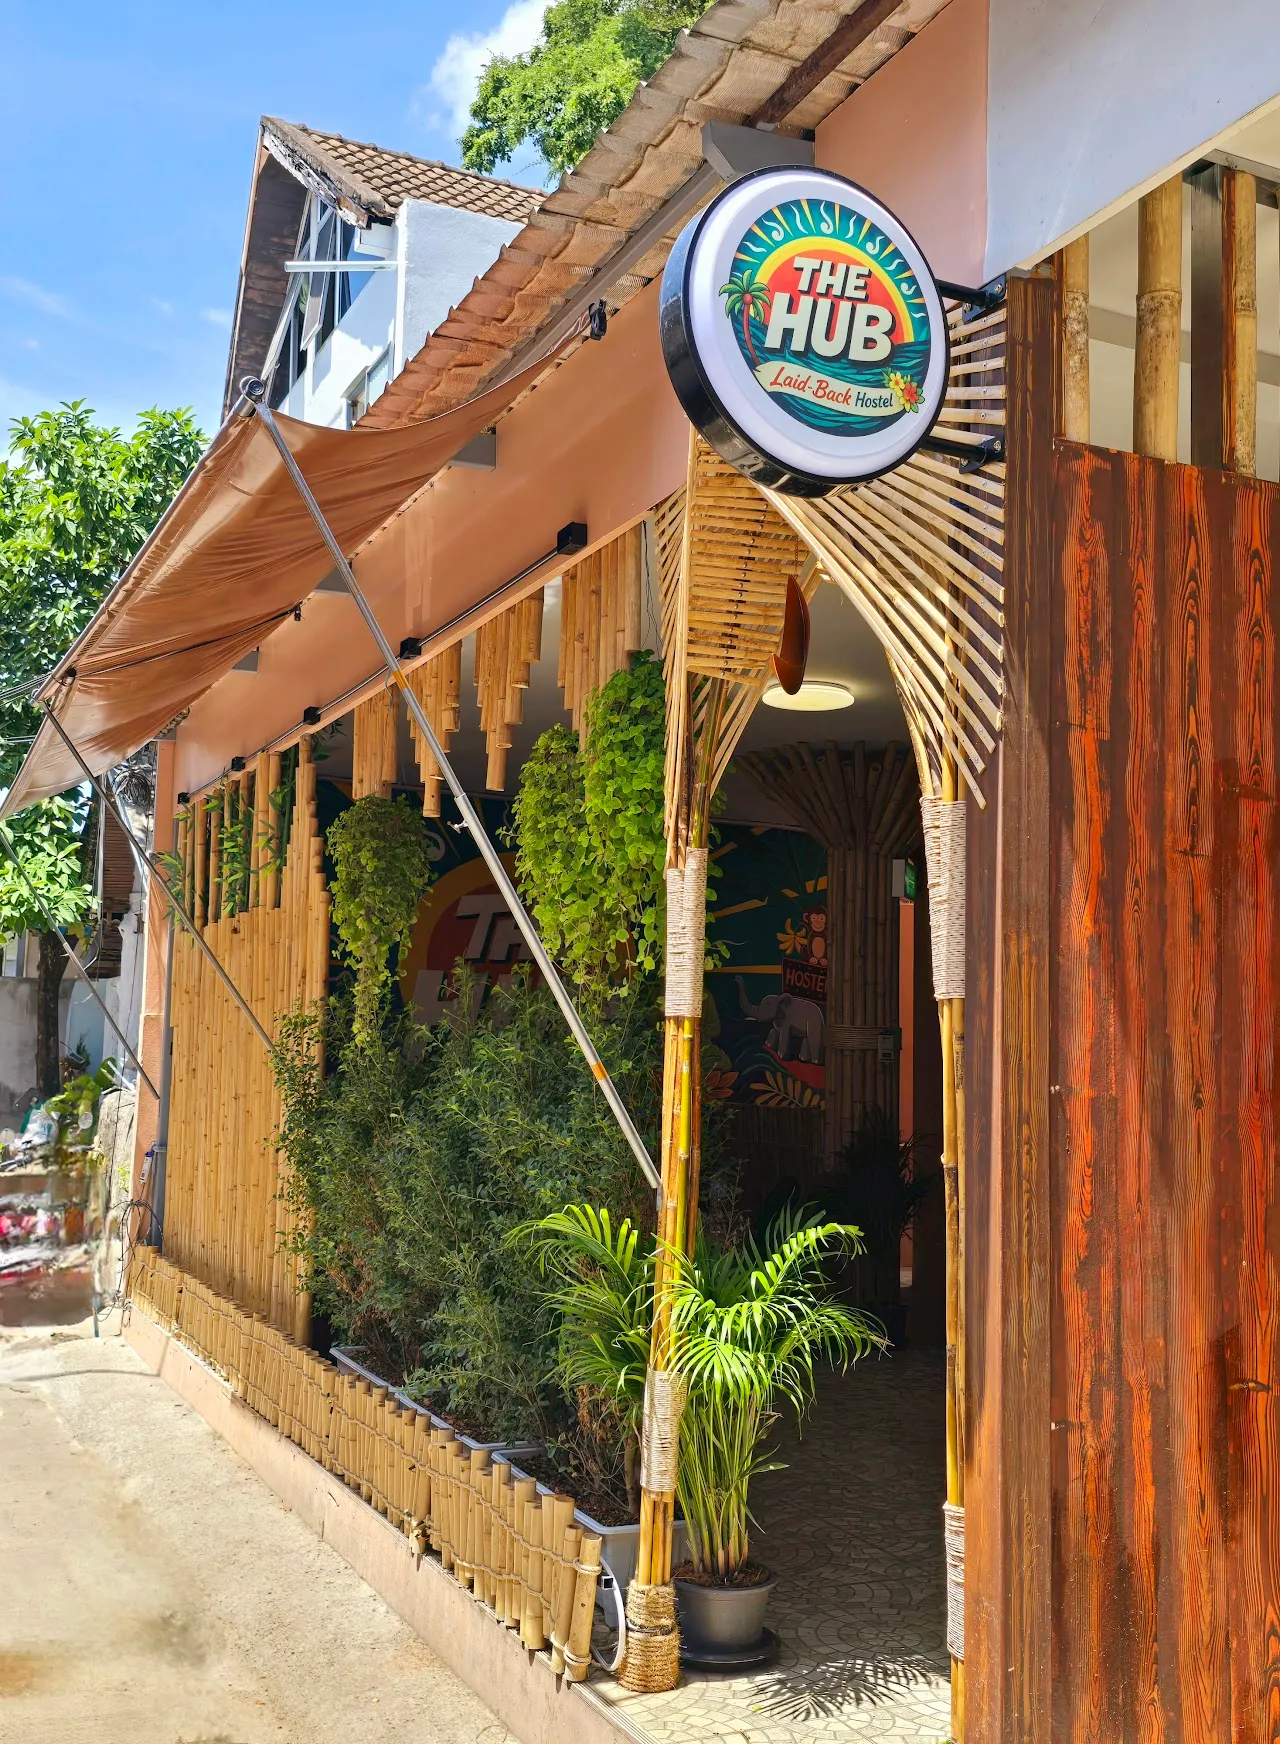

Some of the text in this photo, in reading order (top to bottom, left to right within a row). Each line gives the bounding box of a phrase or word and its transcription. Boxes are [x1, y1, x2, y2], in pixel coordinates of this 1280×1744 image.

[793, 256, 871, 299] THE
[764, 291, 896, 365] HUB
[769, 366, 894, 409] Laid-Back Hostel
[785, 967, 827, 993] HOSTE
